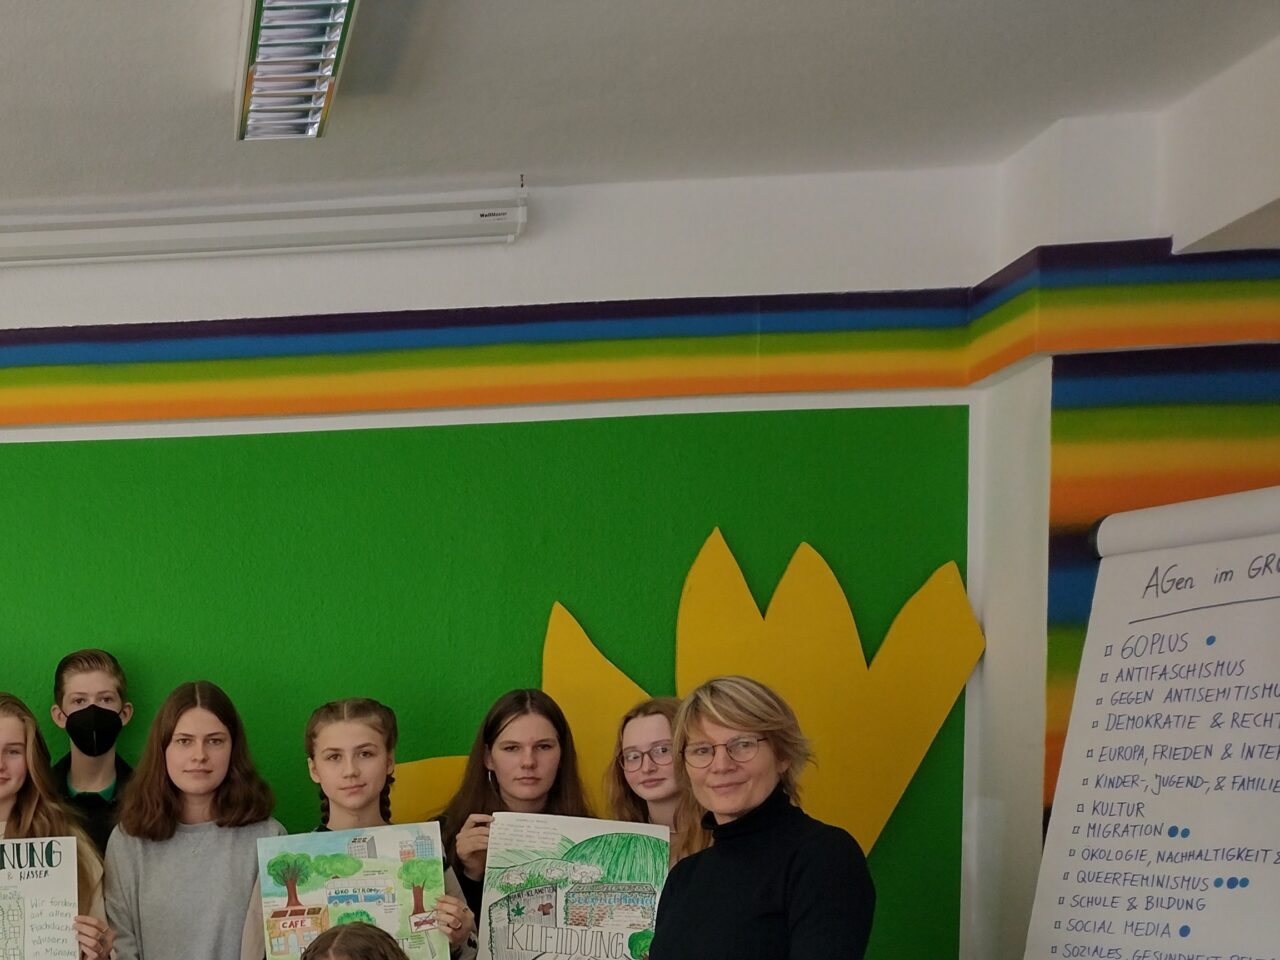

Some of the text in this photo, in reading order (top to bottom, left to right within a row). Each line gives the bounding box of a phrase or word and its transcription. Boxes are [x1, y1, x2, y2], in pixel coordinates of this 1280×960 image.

[1142, 564, 1196, 598] AGen
[1213, 567, 1234, 584] im
[1115, 659, 1246, 684] ANTIFASCHISMUS
[1110, 688, 1154, 706] GEGEN
[1105, 713, 1201, 731] DEMOKRATIE
[1210, 712, 1226, 729] &
[1098, 744, 1148, 765] EUROPA,
[1153, 744, 1214, 760] FRIEDEN
[1221, 743, 1233, 760] &
[1213, 775, 1227, 791] &
[1091, 801, 1145, 818] KULTUR
[1086, 822, 1165, 839] MIGRATION
[1156, 847, 1272, 864] NACHHALTIGKEIT
[20, 869, 49, 881] WASSER
[1076, 871, 1210, 892] QUEERFEMINISMUS
[1070, 896, 1207, 912] SCHULE & BILDUNG
[1066, 919, 1171, 938] SOCIAL MEDIA
[507, 923, 624, 959] KLEIDUNG
